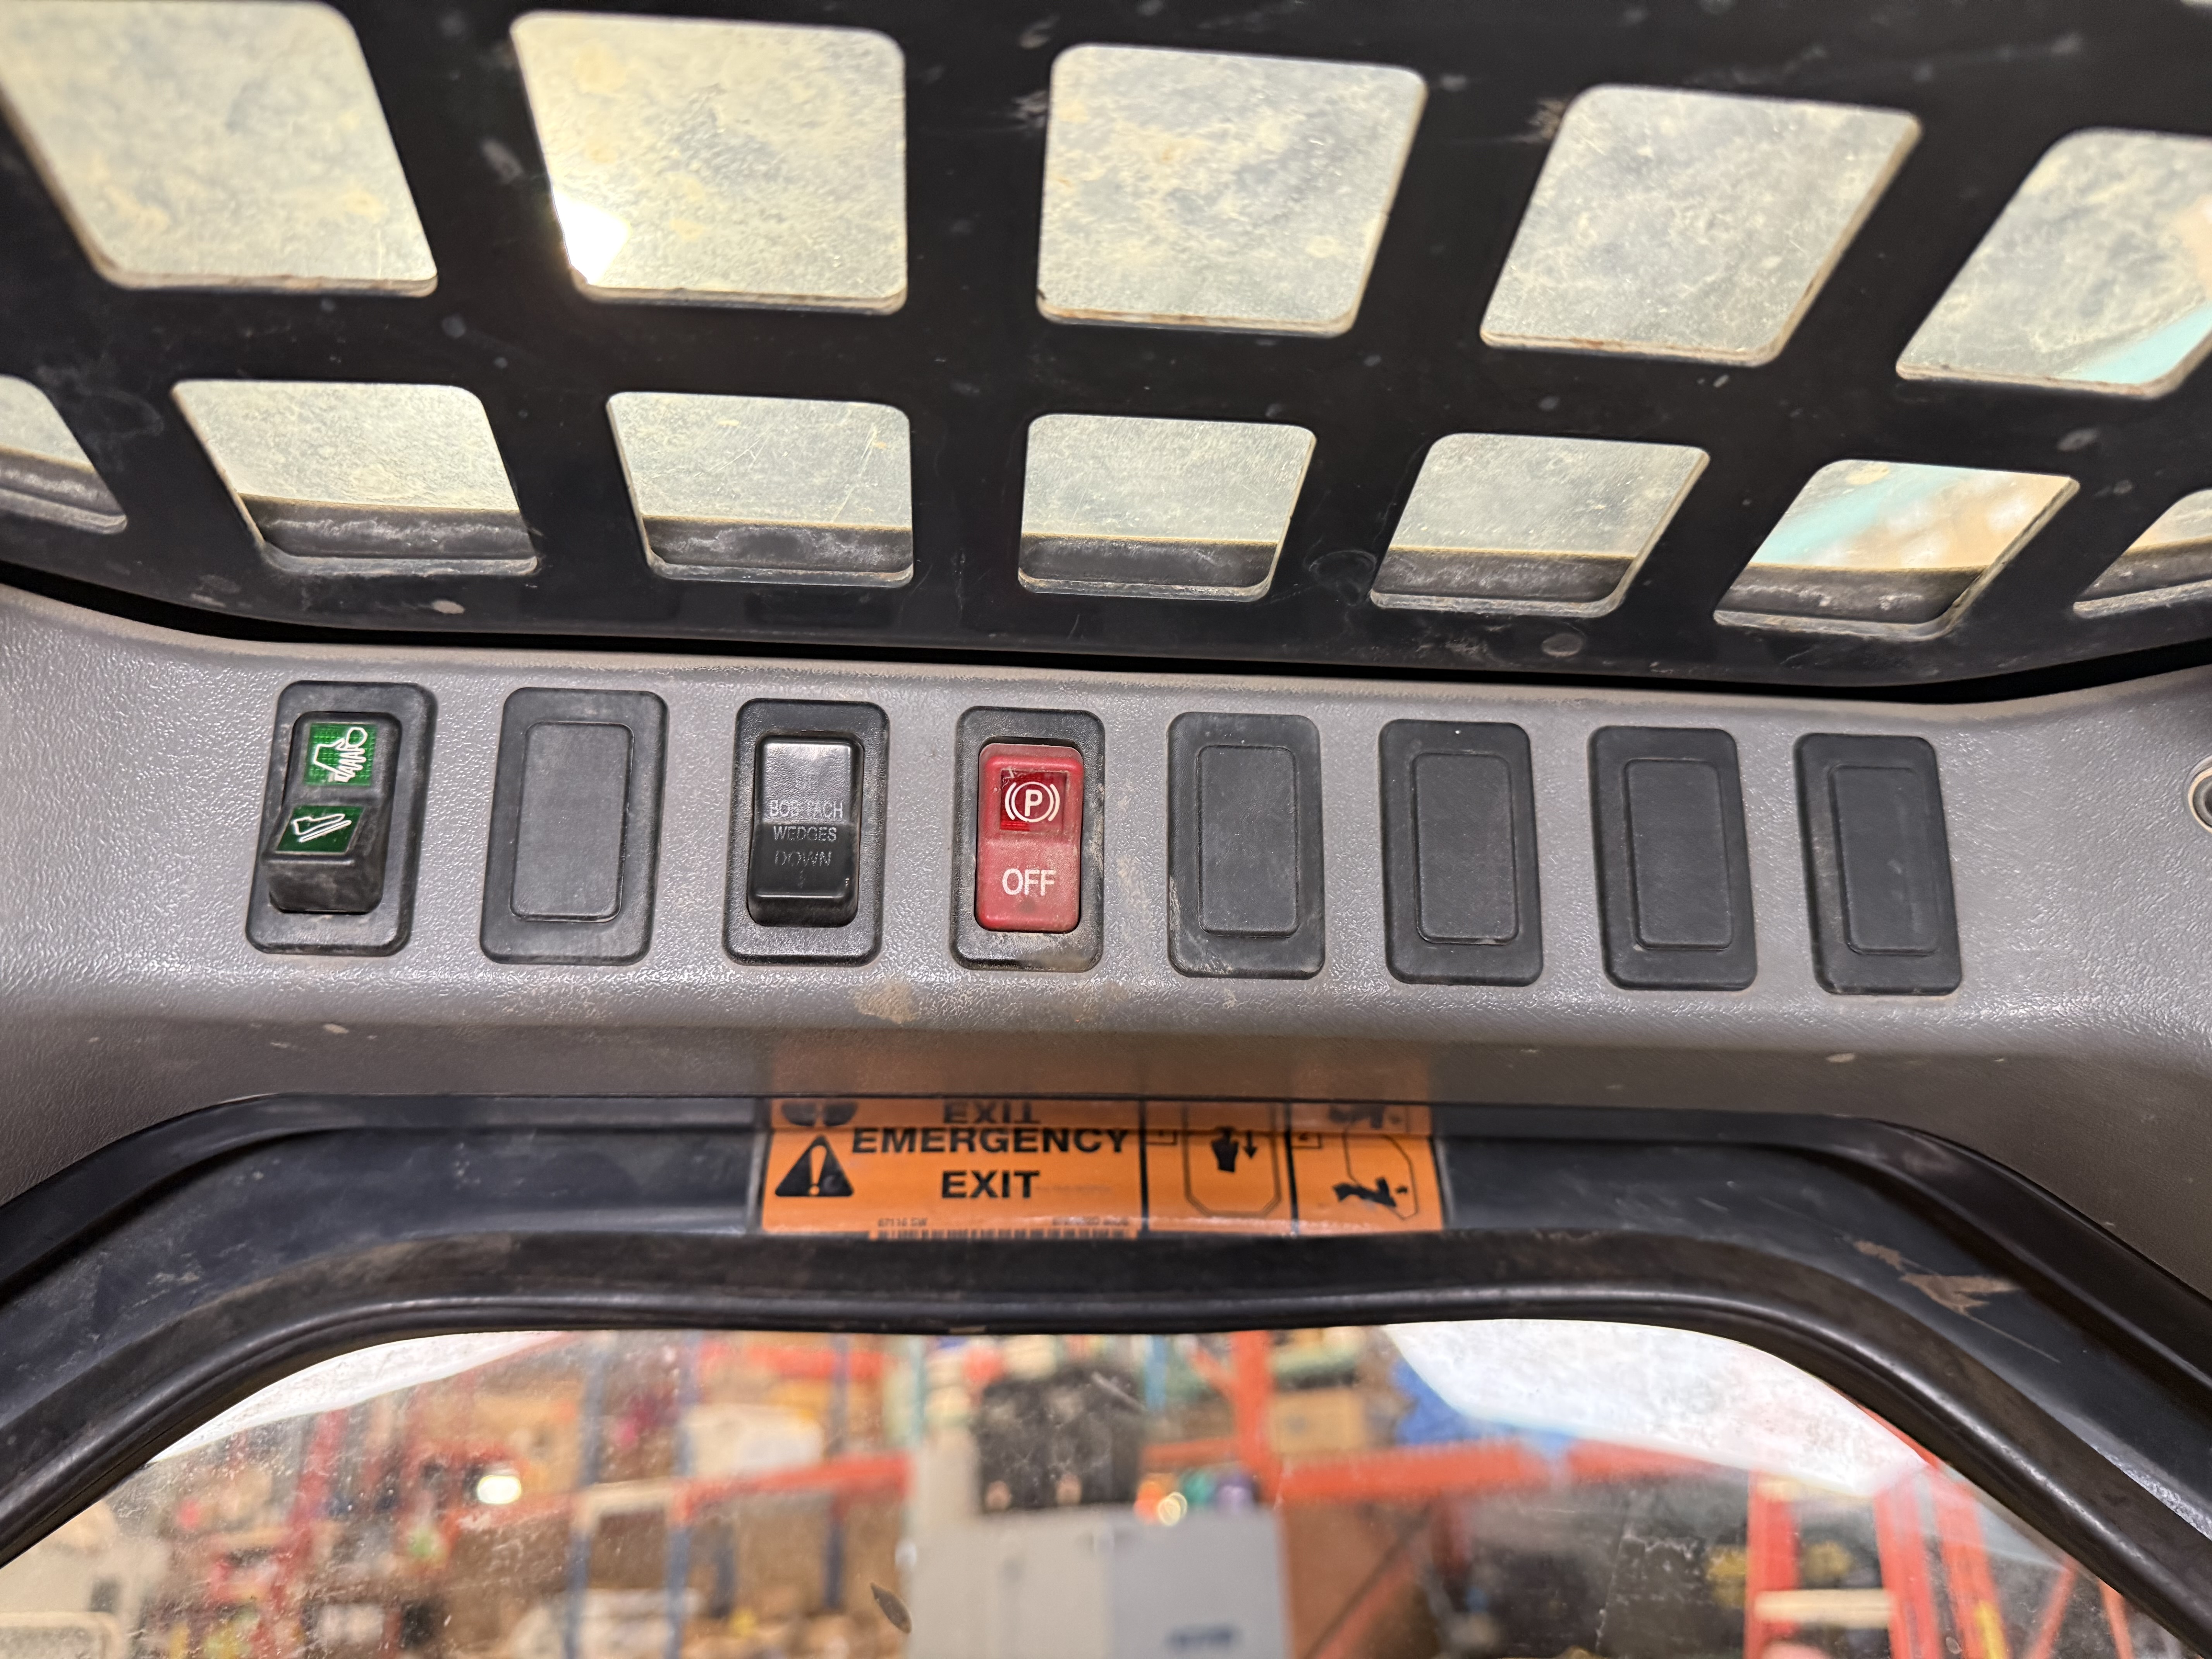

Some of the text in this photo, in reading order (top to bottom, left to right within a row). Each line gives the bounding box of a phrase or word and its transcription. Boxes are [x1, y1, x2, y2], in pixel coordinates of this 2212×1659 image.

[773, 826, 837, 842] WEDGES
[775, 851, 832, 867] DOWN
[1002, 868, 1056, 896] OFF
[852, 1128, 1128, 1154] EMERGENCY
[942, 1171, 1040, 1198] EXIT
